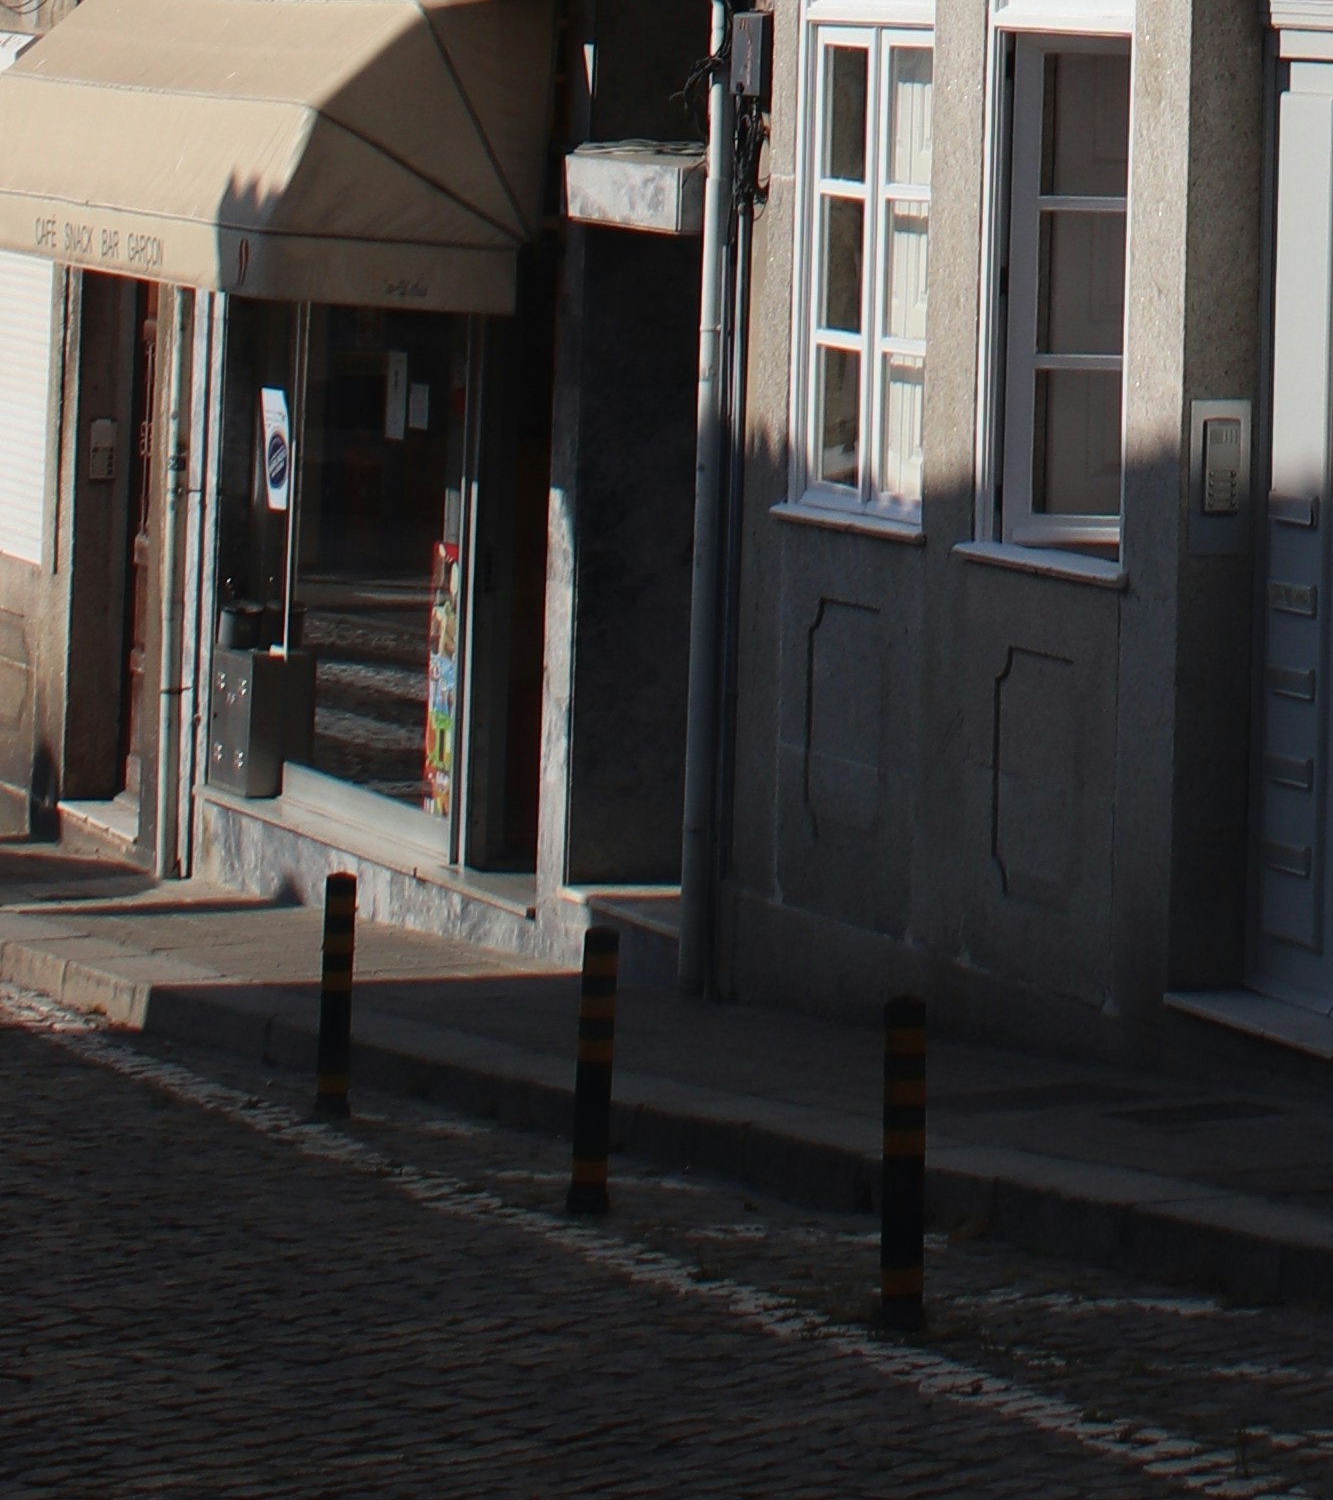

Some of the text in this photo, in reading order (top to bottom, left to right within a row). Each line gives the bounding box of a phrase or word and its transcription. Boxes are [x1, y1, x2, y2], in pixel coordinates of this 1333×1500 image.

[35, 214, 164, 271] CAFÉ SNACK BAR GARÇON
